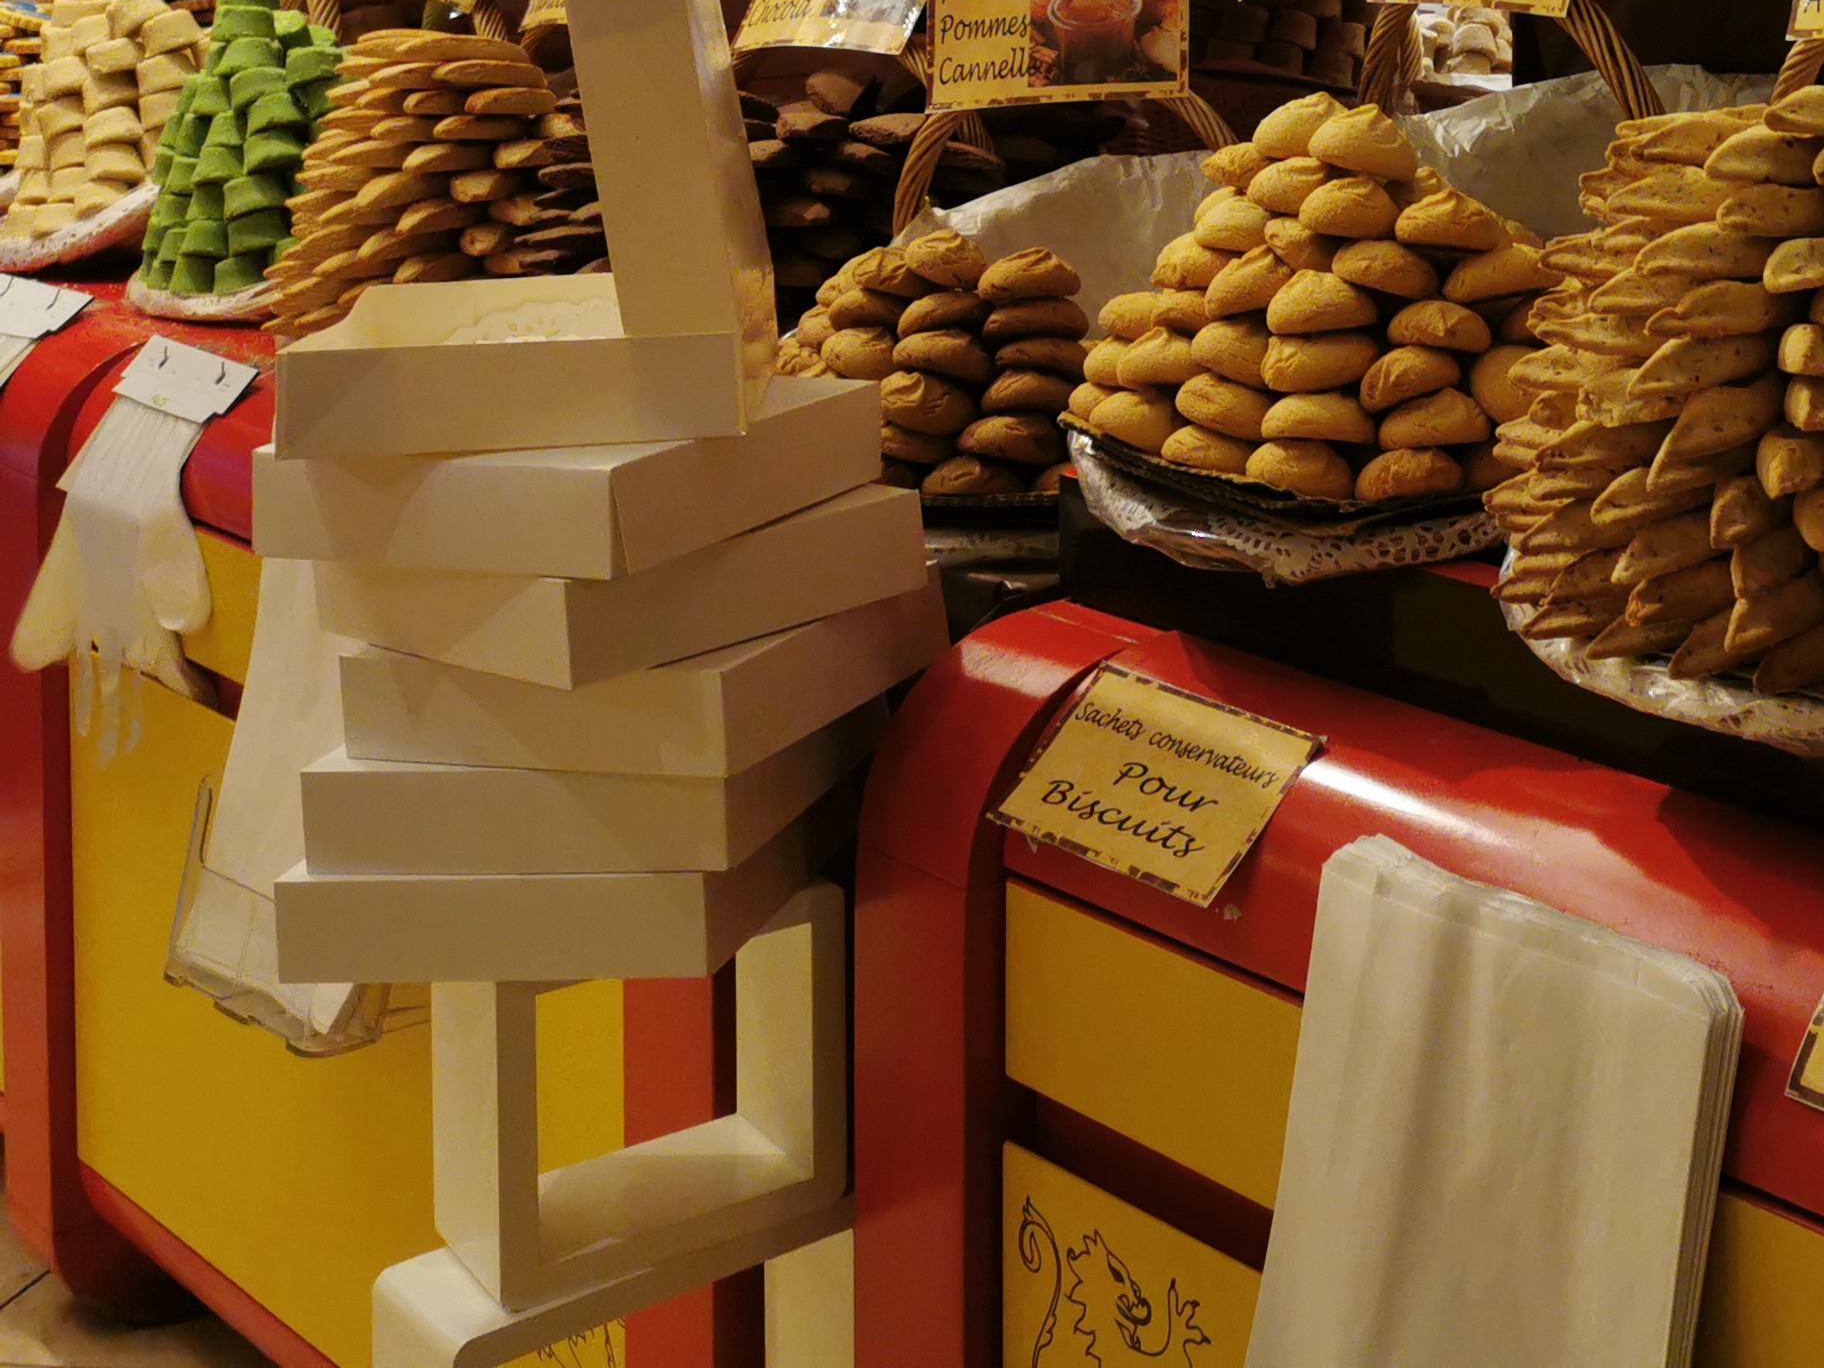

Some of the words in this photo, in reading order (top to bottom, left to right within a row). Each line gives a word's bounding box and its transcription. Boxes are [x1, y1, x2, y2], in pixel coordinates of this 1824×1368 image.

[940, 13, 1032, 45] Pommes
[938, 46, 1042, 86] Cannelle
[1074, 701, 1148, 741] Sachets
[1148, 729, 1279, 790] conservateurs
[1112, 761, 1219, 814] Pour
[1040, 779, 1206, 859] Biscuits
